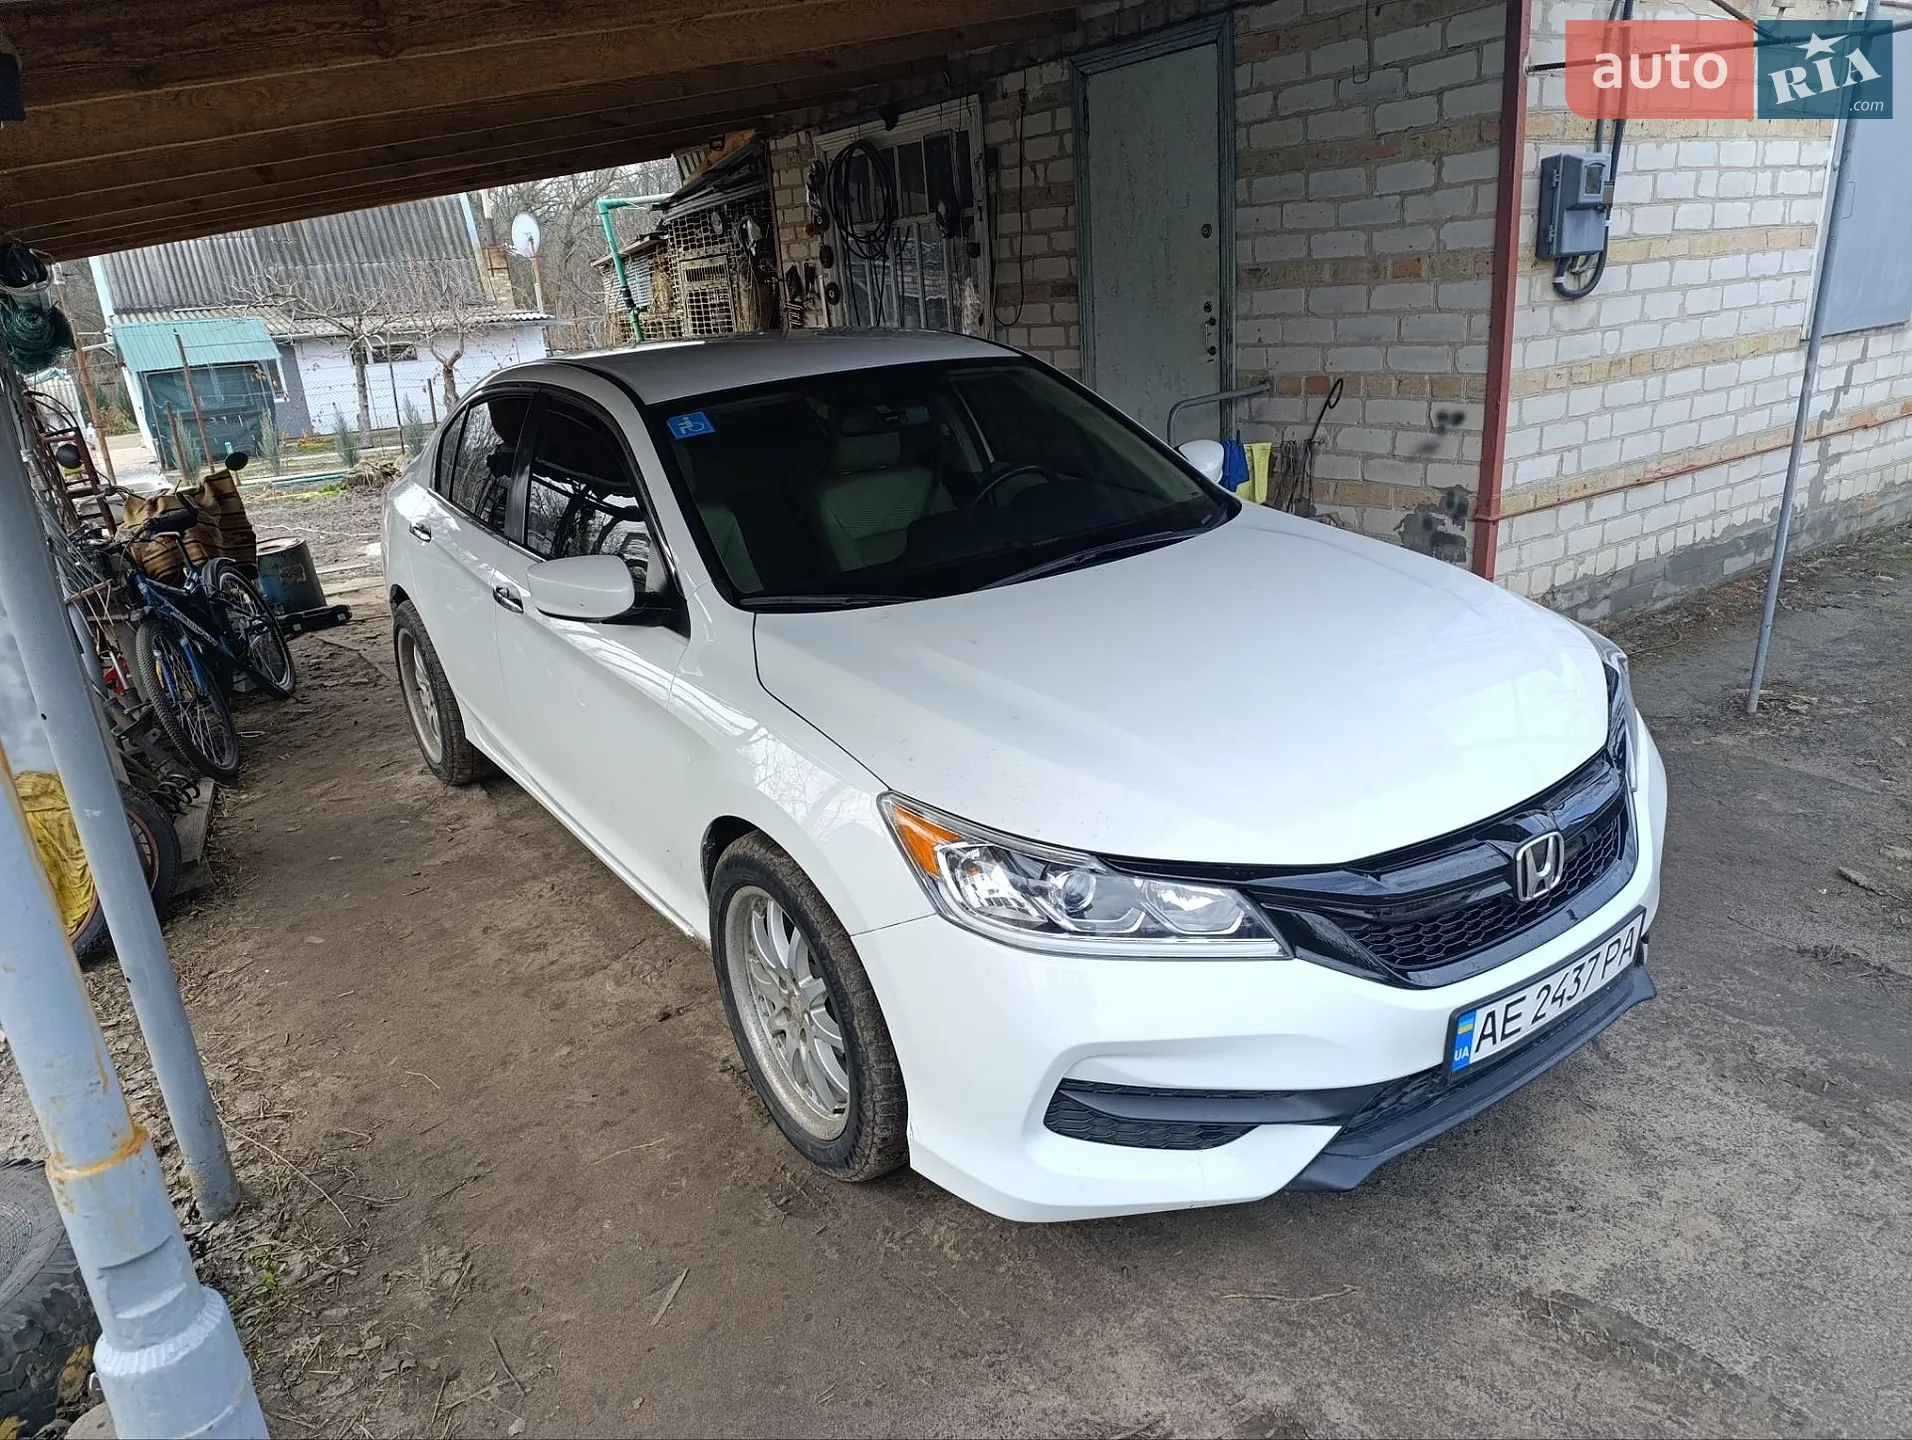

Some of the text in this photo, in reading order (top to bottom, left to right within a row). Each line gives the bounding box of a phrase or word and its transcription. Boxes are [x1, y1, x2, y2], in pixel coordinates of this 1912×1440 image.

[1474, 926, 1635, 1054] AE 2437 PA
[1454, 1046, 1470, 1061] UA
